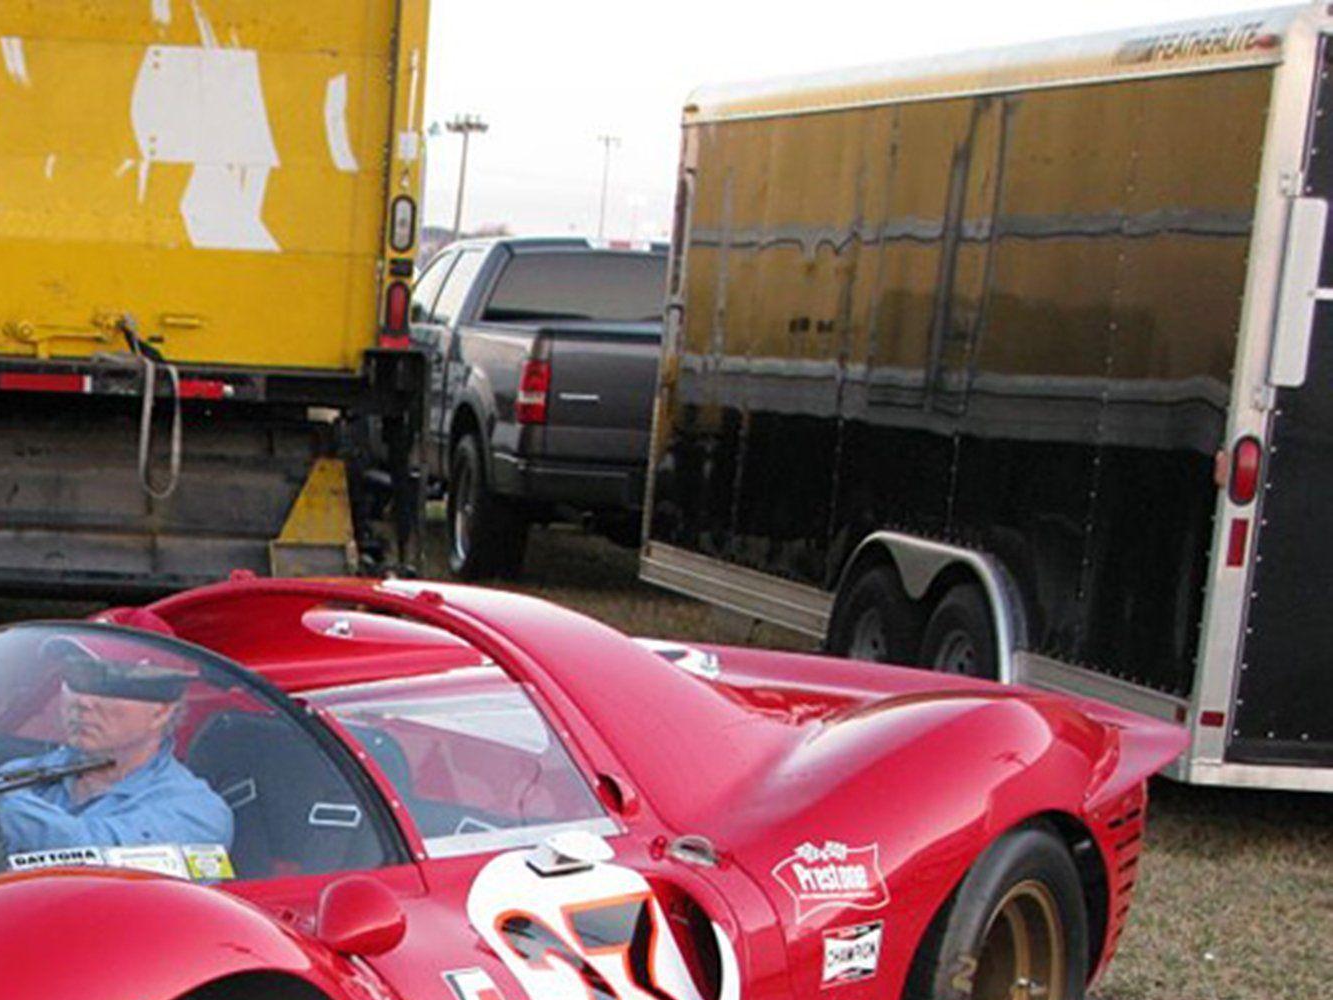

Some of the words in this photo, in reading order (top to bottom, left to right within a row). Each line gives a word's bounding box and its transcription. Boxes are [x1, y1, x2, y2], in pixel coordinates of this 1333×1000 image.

[14, 849, 97, 866] DAYTONA
[791, 861, 870, 891] Prestone
[826, 941, 877, 968] CHAMPION
